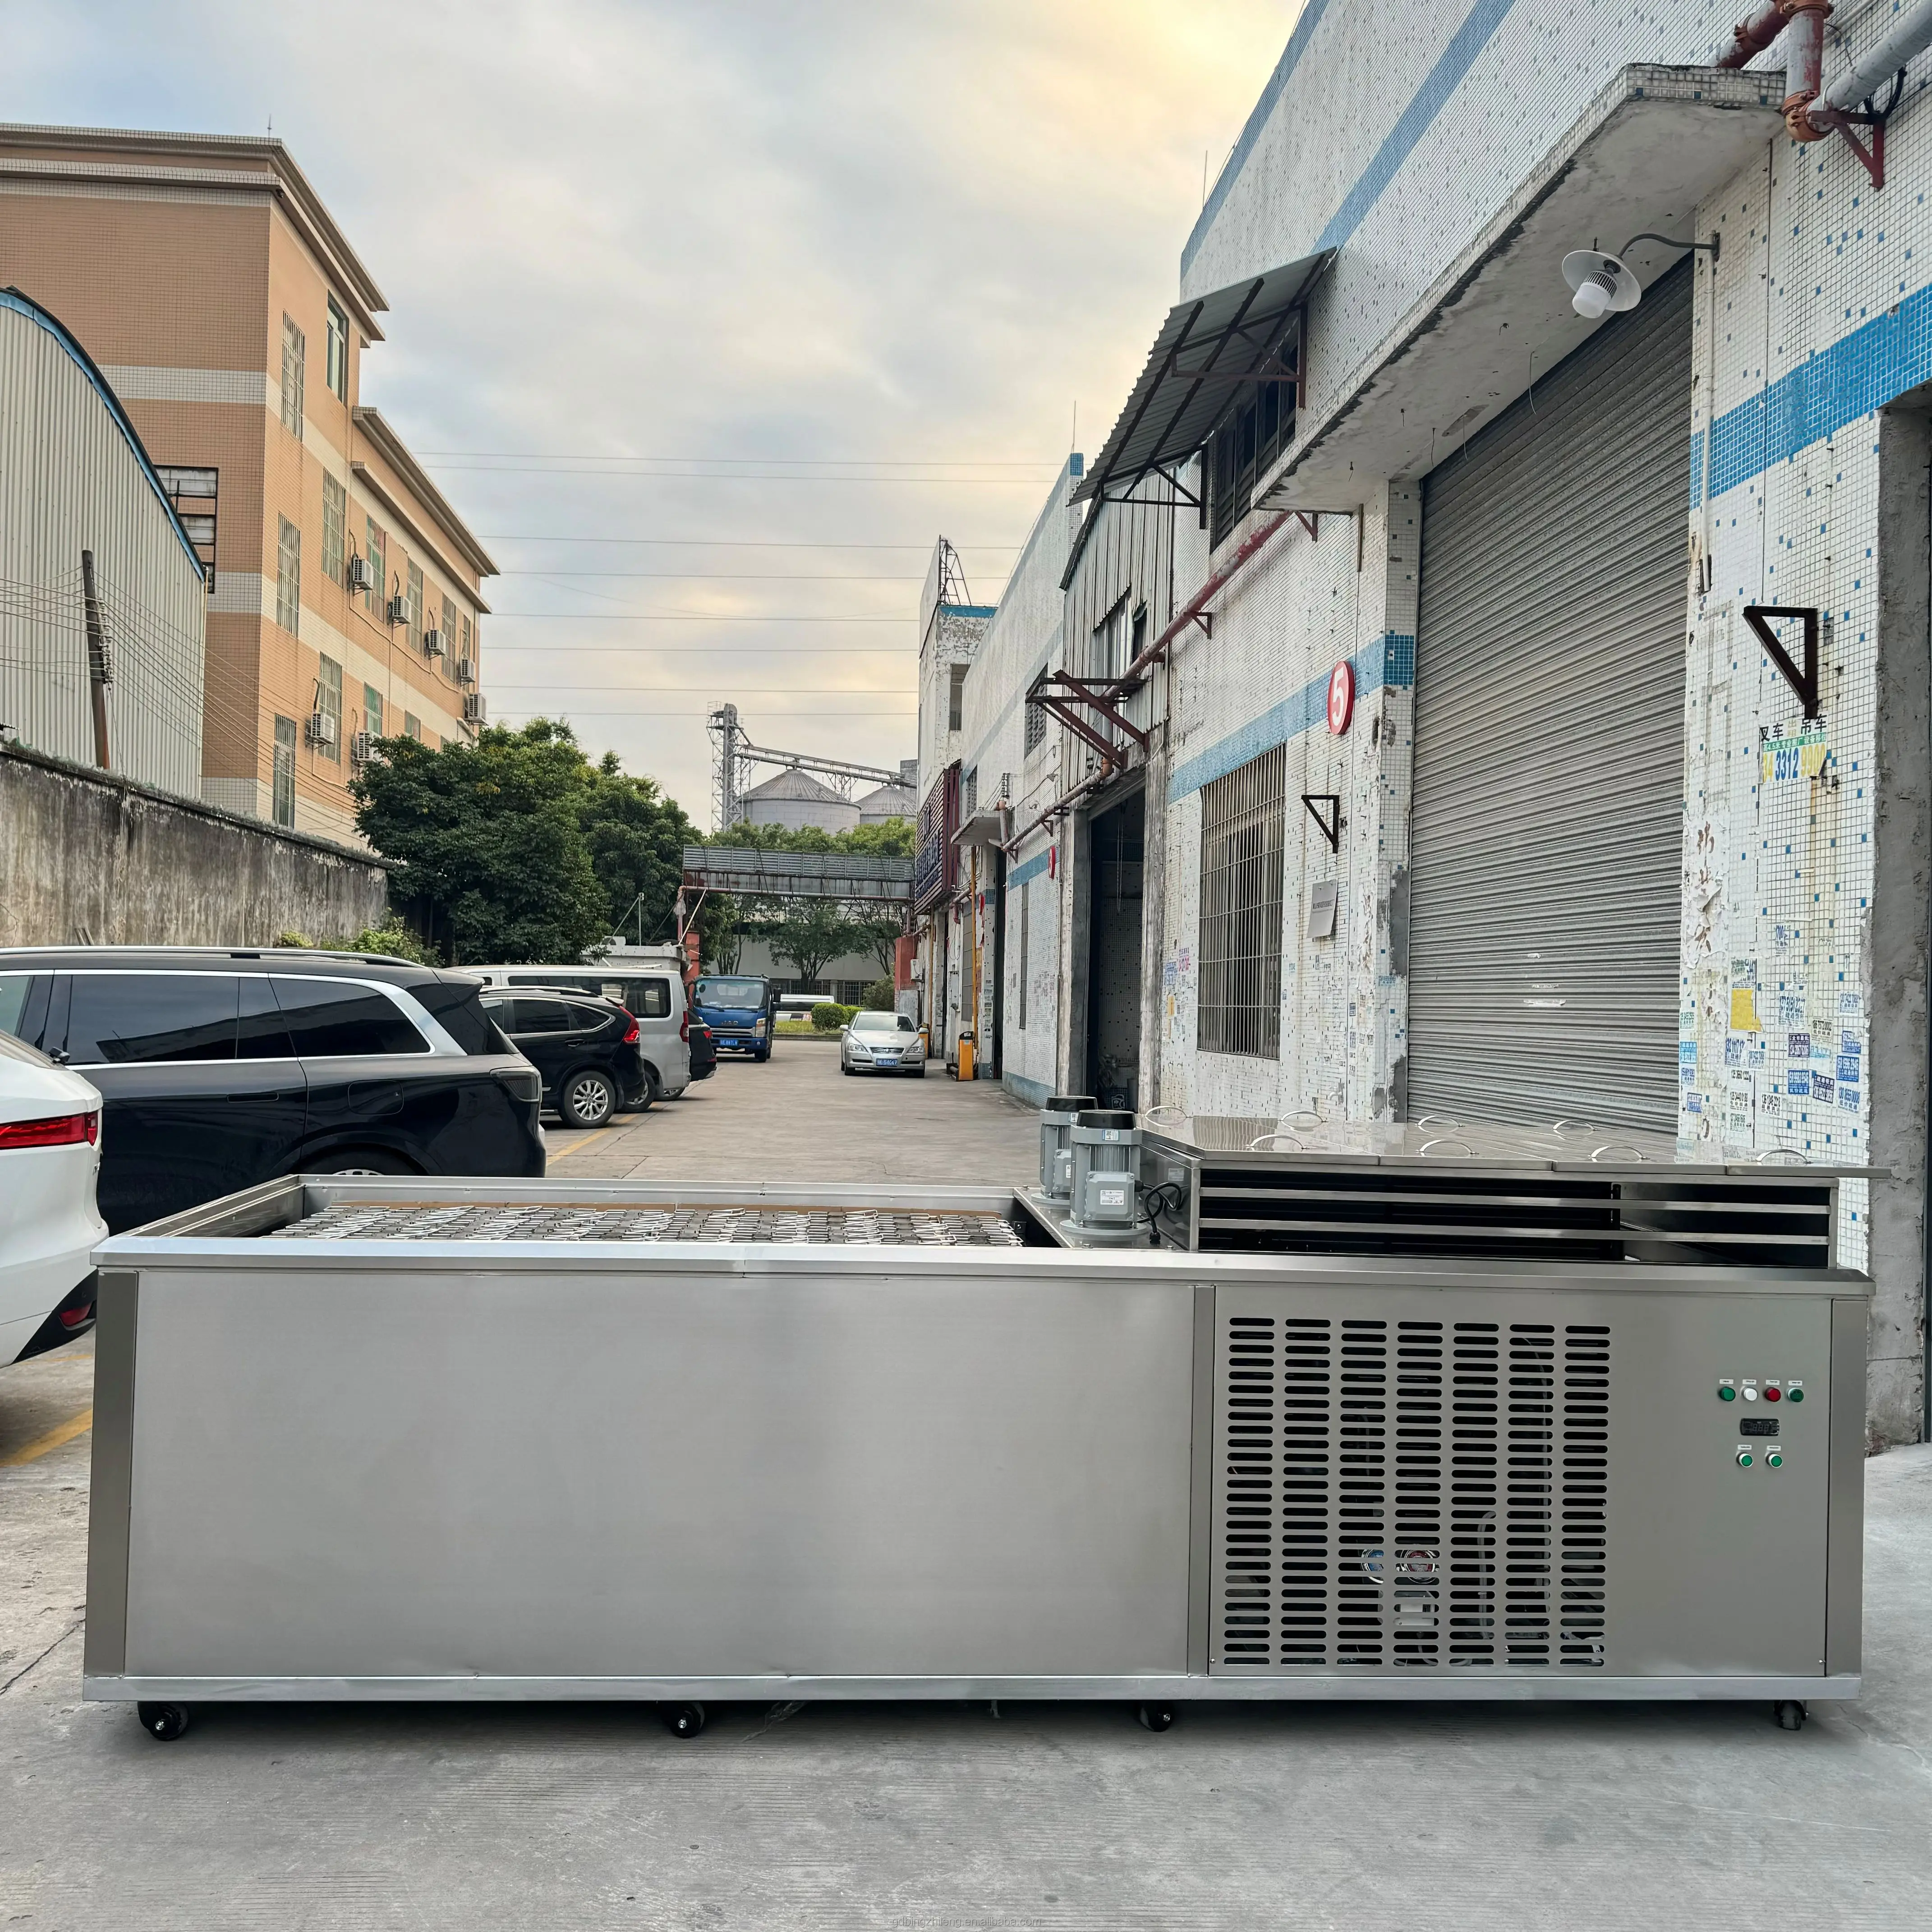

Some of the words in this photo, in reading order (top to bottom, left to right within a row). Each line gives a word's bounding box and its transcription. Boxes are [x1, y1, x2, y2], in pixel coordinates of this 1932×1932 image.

[1332, 667, 1344, 726] 5
[1759, 722, 1784, 741] 叉车
[1775, 747, 1799, 781] 3312
